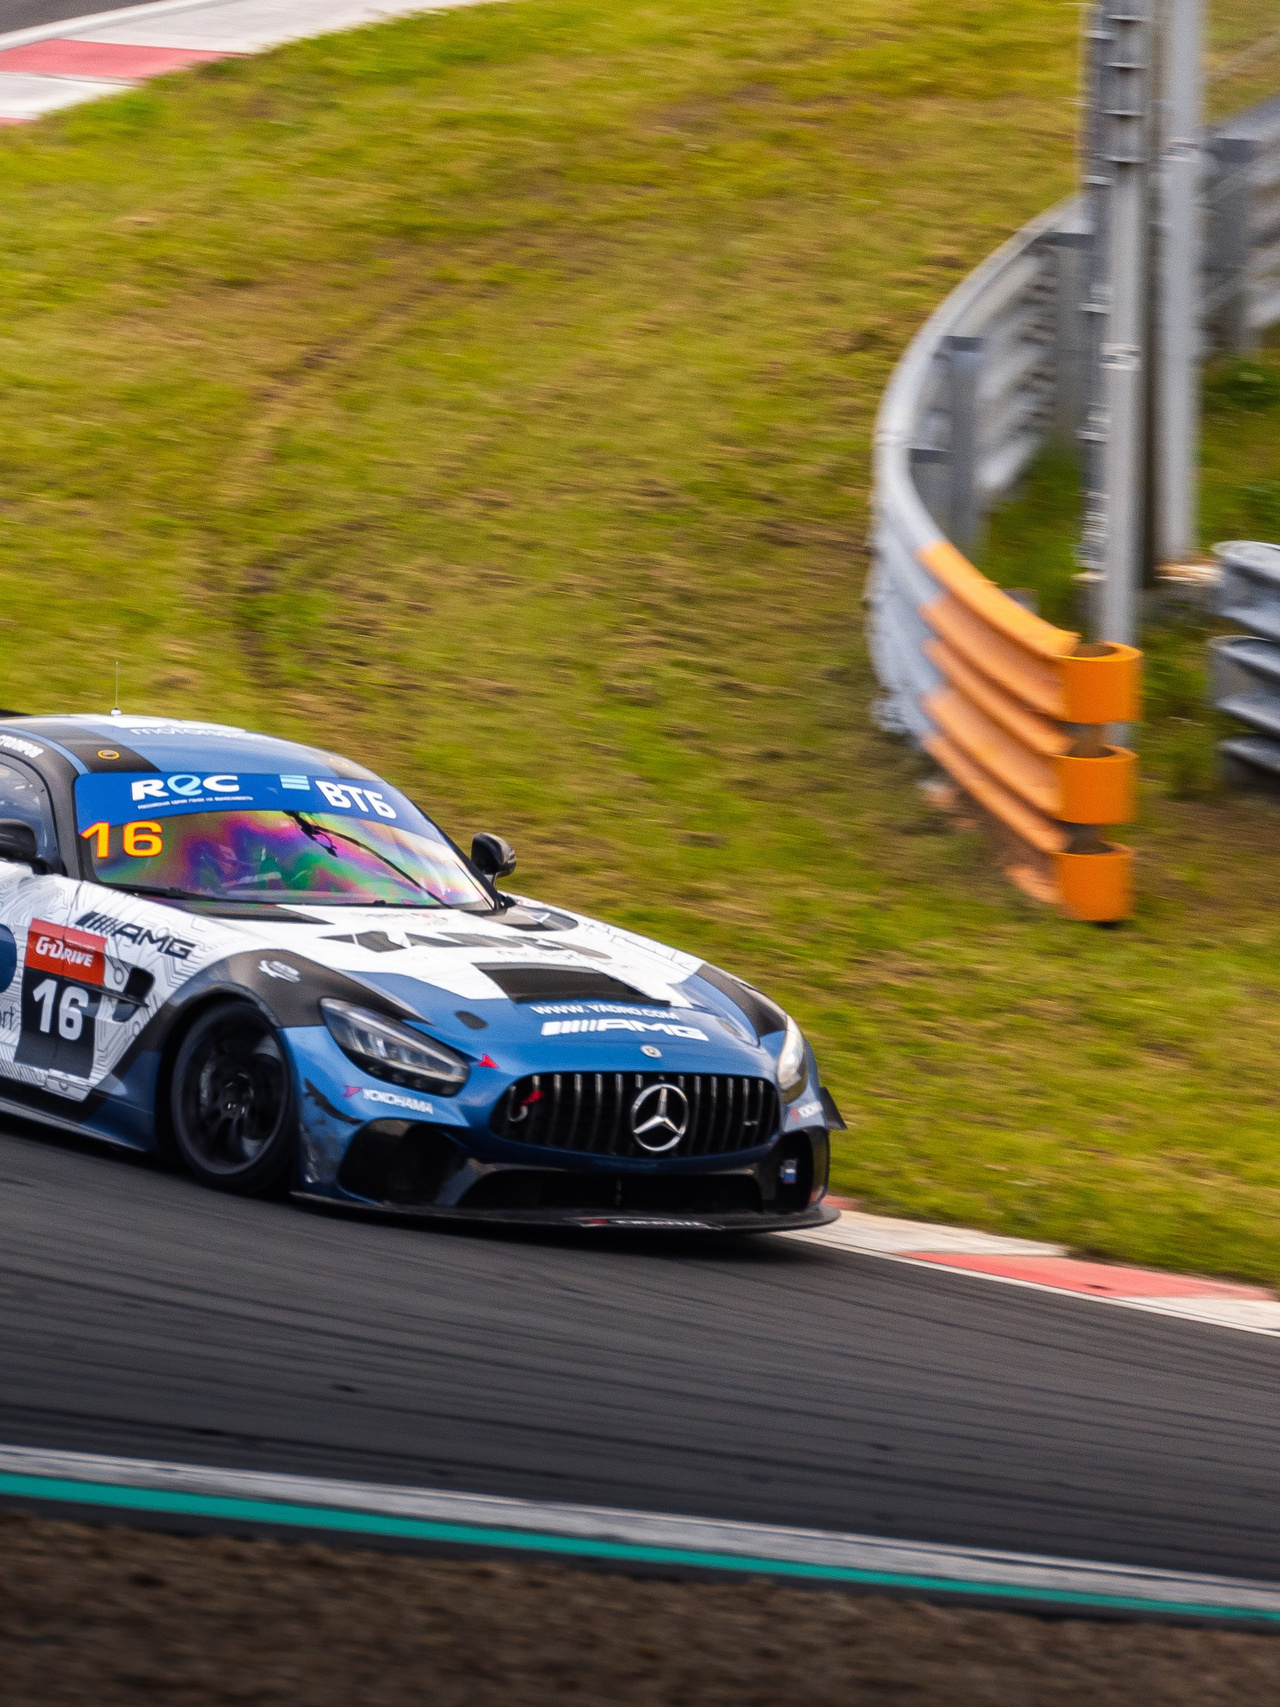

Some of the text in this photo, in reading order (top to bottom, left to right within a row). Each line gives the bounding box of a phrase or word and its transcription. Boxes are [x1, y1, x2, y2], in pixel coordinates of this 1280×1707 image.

[314, 780, 397, 819] ВТБ
[80, 821, 163, 859] 16
[108, 922, 197, 960] AMG
[32, 978, 89, 1041] 16
[596, 1018, 710, 1042] AMG
